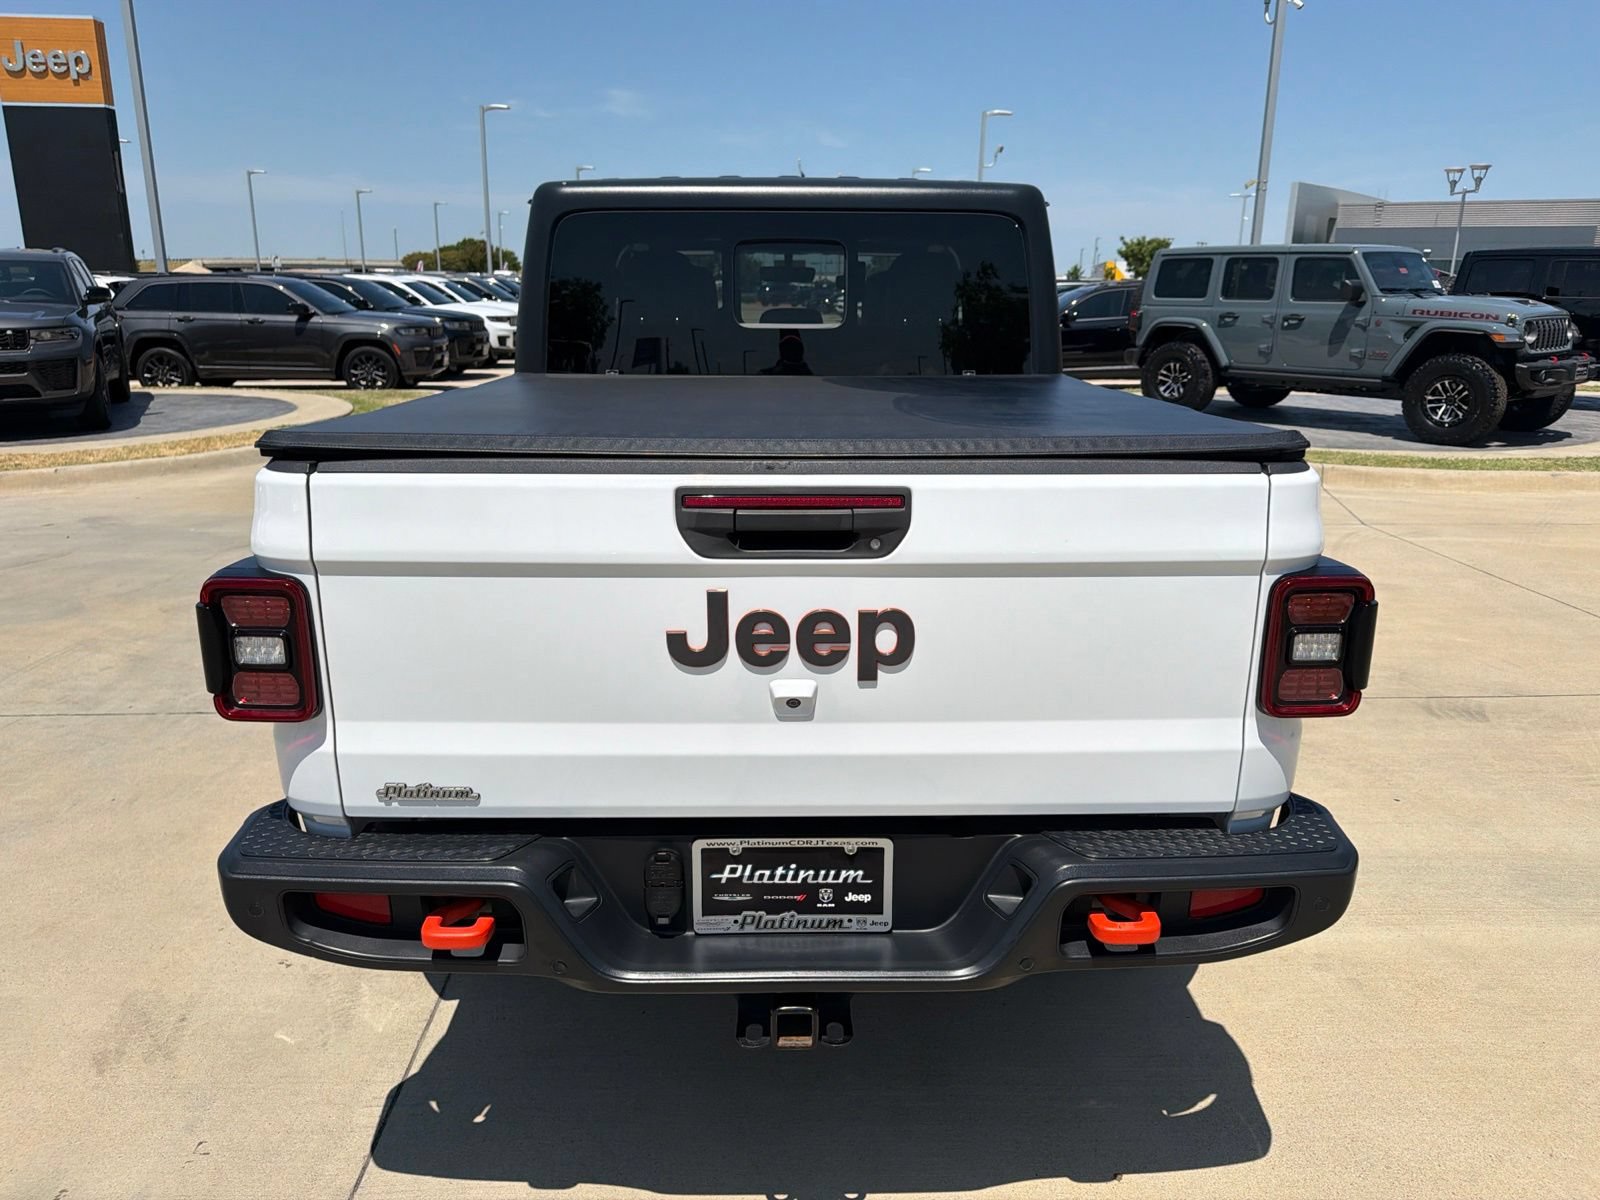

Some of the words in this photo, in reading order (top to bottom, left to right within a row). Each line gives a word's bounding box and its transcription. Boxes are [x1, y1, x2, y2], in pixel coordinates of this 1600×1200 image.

[2, 38, 91, 80] Jeep
[1411, 308, 1500, 321] RUBICON
[665, 588, 916, 682] Jeep
[376, 782, 480, 801] Platinum
[705, 839, 879, 847] www.PlatinumCDRJTexas.com
[709, 863, 874, 884] Platinum
[844, 891, 872, 903] Jeep
[738, 912, 852, 931] Platinum
